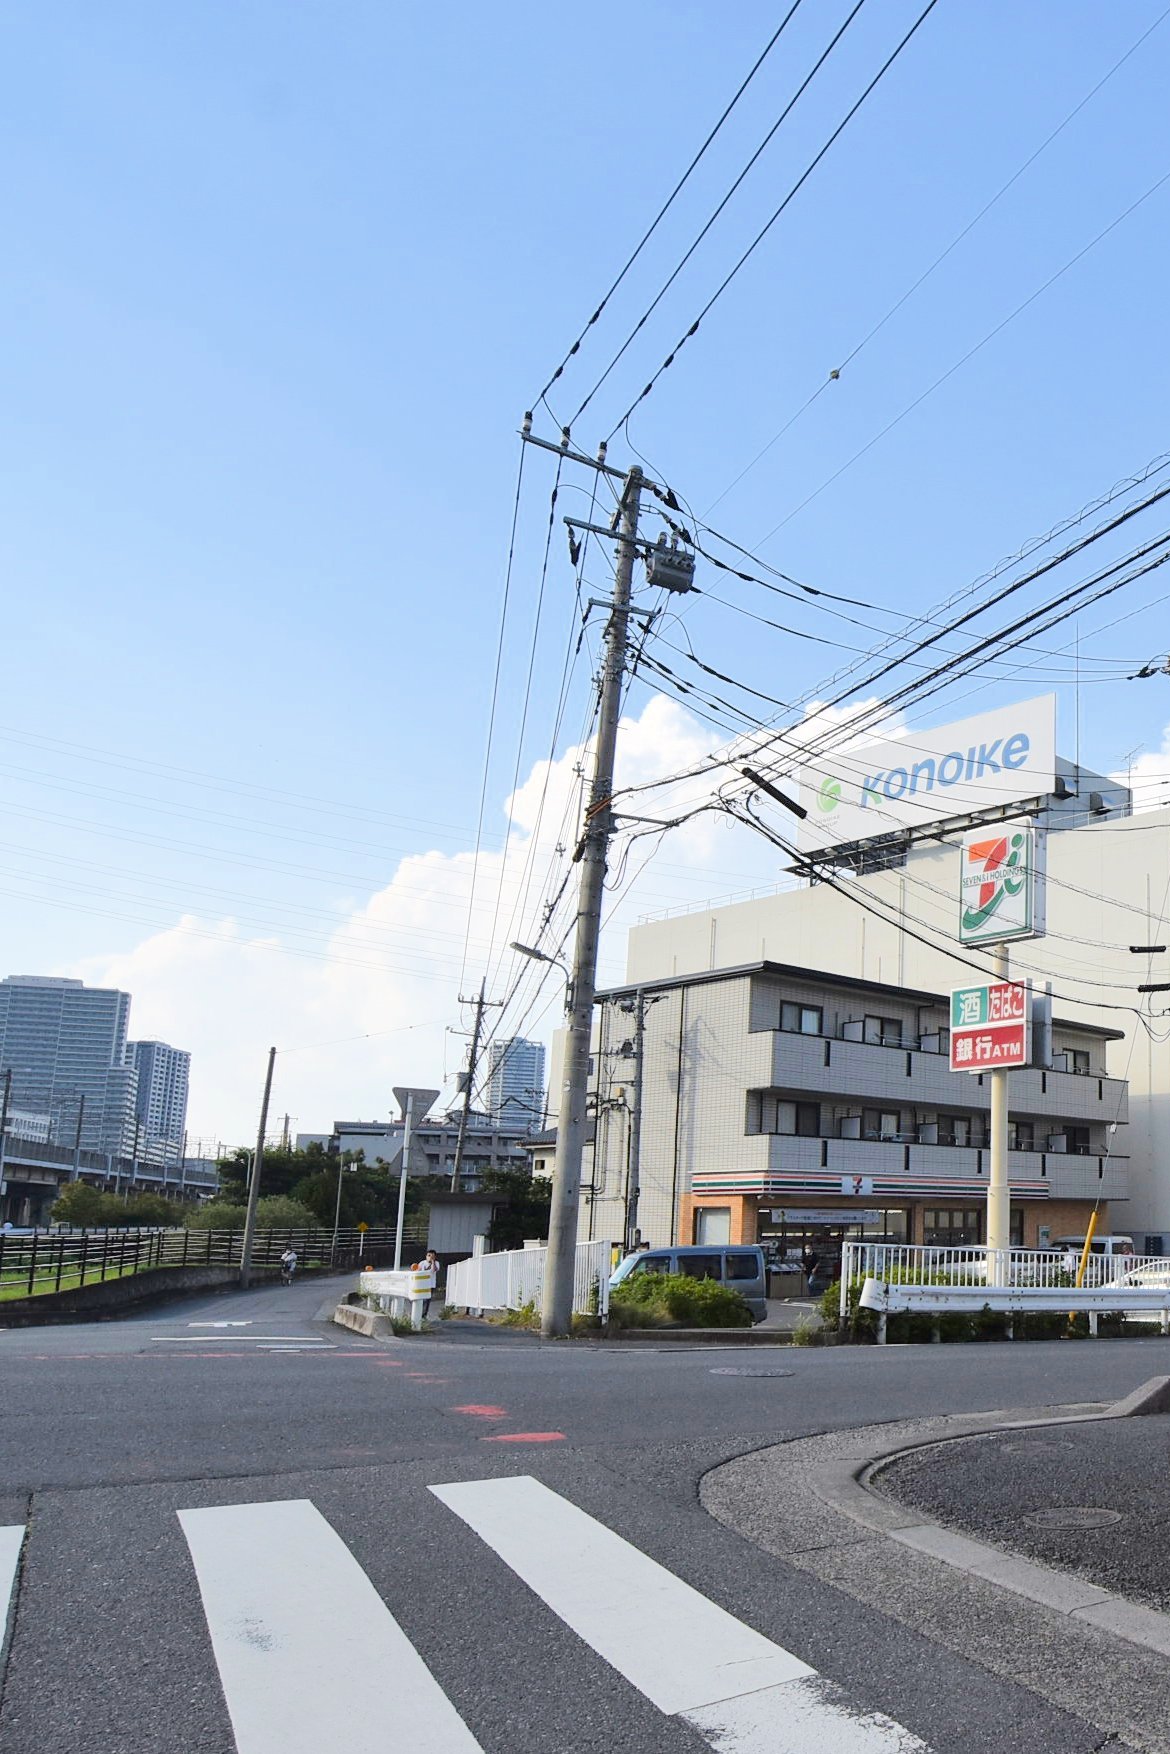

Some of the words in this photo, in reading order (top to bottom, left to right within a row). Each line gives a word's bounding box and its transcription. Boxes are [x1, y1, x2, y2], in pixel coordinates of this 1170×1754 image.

[959, 991, 981, 1025] 酒
[989, 985, 1023, 1020] たばこ
